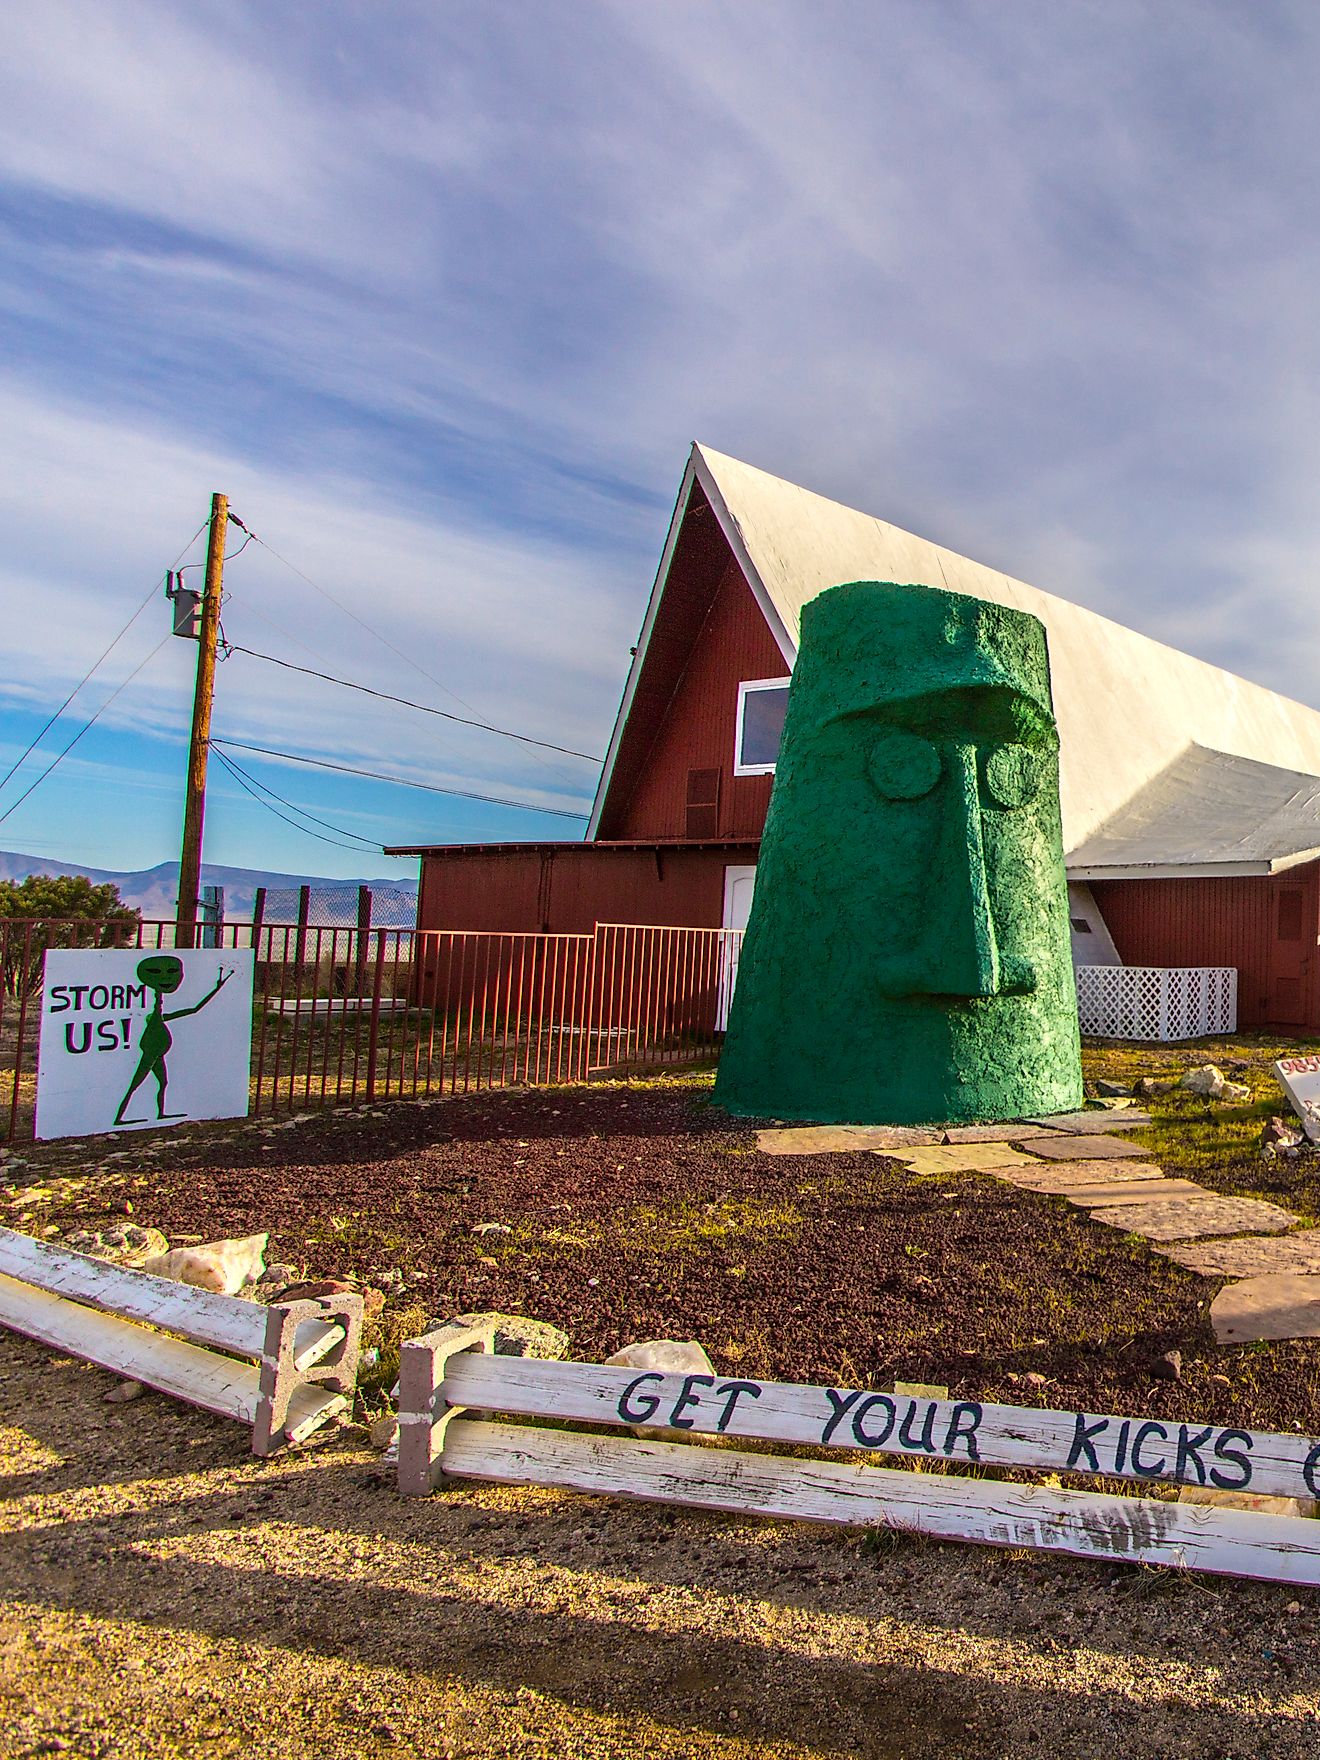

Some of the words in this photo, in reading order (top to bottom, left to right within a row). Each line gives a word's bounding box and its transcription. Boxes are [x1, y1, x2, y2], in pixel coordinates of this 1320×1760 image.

[50, 984, 147, 1013] STORM
[65, 1018, 132, 1054] US!
[616, 1372, 763, 1432] GET
[820, 1388, 984, 1462] YOUR
[1065, 1413, 1254, 1489] KICKS
